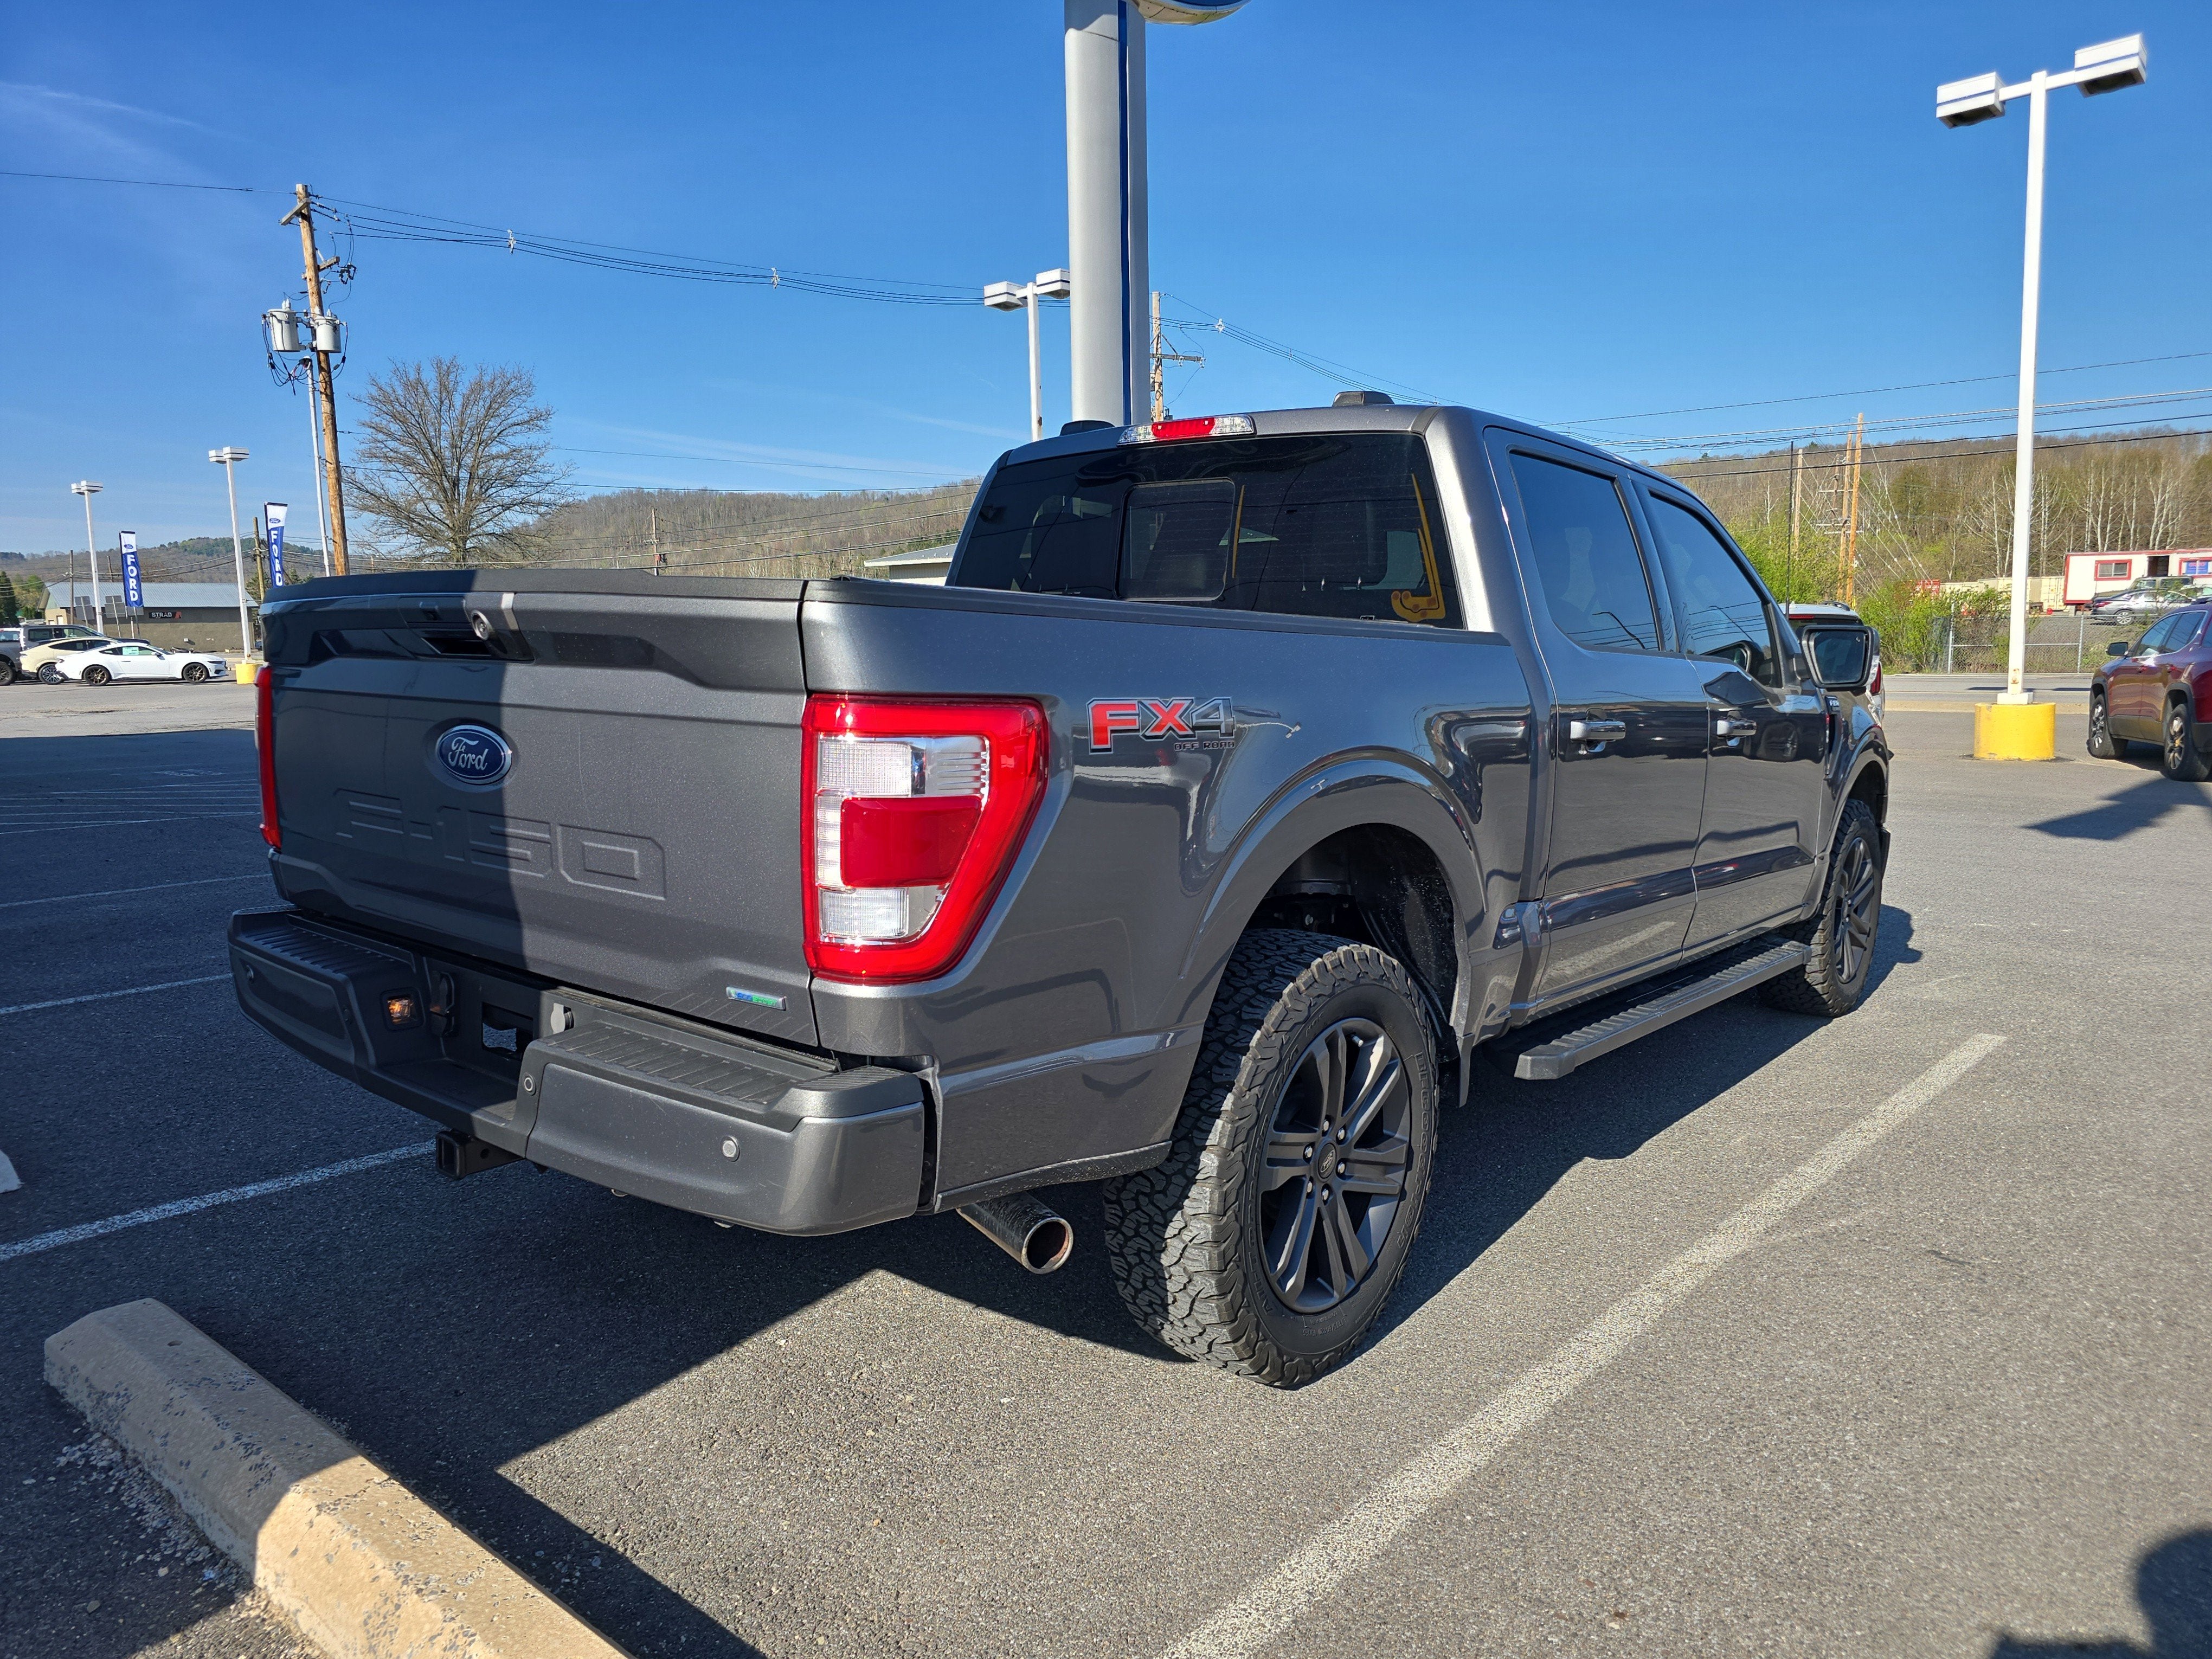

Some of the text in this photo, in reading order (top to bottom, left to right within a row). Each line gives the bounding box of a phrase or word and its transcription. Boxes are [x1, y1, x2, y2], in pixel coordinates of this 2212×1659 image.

[126, 554, 138, 601] FORD
[270, 530, 282, 586] FORD
[1086, 697, 1236, 755] FX4
[1174, 741, 1235, 751] OFF ROAD
[448, 737, 488, 770] Ford
[333, 788, 666, 901] F-150
